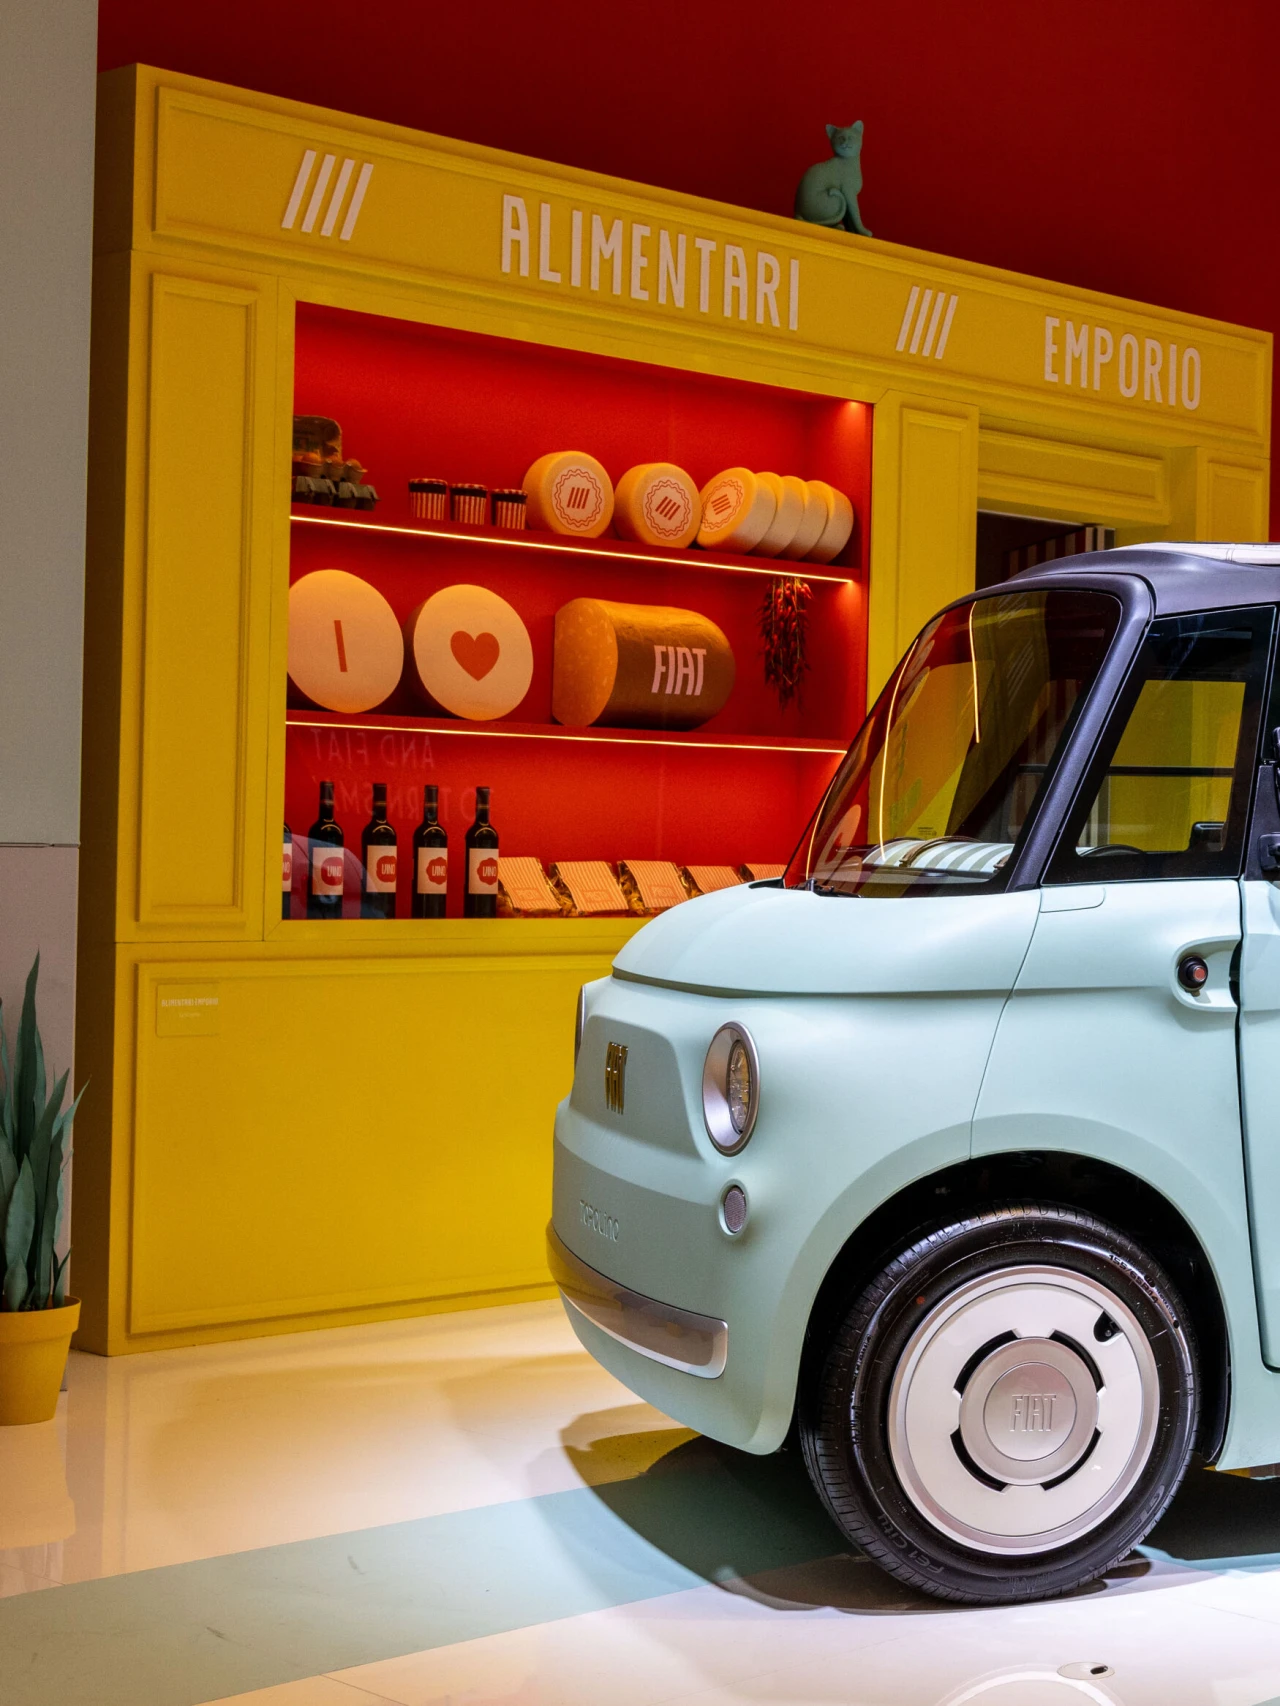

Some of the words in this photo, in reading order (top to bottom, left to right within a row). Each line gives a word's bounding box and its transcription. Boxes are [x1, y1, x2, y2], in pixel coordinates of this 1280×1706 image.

[501, 193, 800, 331] ALIMENTARI
[1044, 315, 1202, 411] EMPORIO
[651, 644, 707, 697] FIAT
[604, 1041, 629, 1116] FIAT
[1009, 1393, 1057, 1432] FIAT
